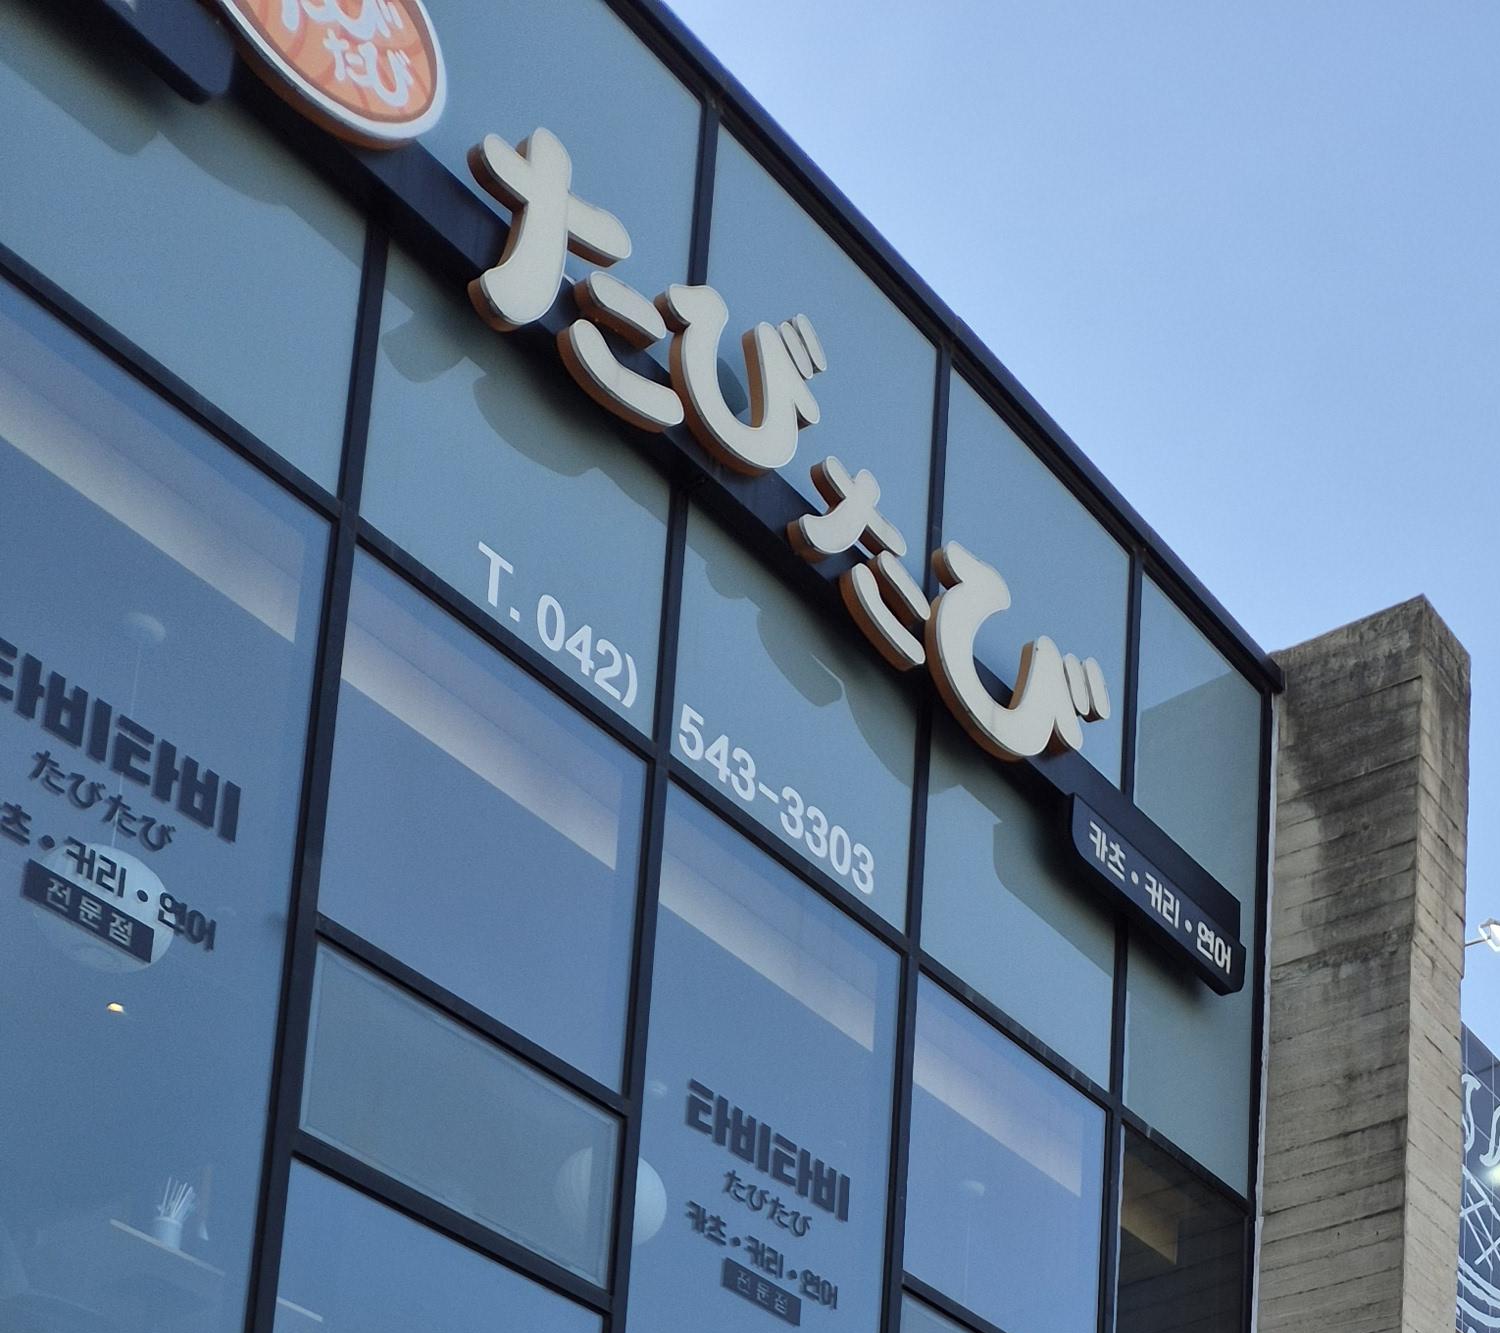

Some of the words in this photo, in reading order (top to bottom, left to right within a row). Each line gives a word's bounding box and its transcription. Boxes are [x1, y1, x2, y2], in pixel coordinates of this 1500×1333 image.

[28, 750, 176, 852] たびたび
[536, 593, 640, 708] 042)
[678, 703, 875, 895] 543-3303
[686, 1078, 850, 1222] 타비타비
